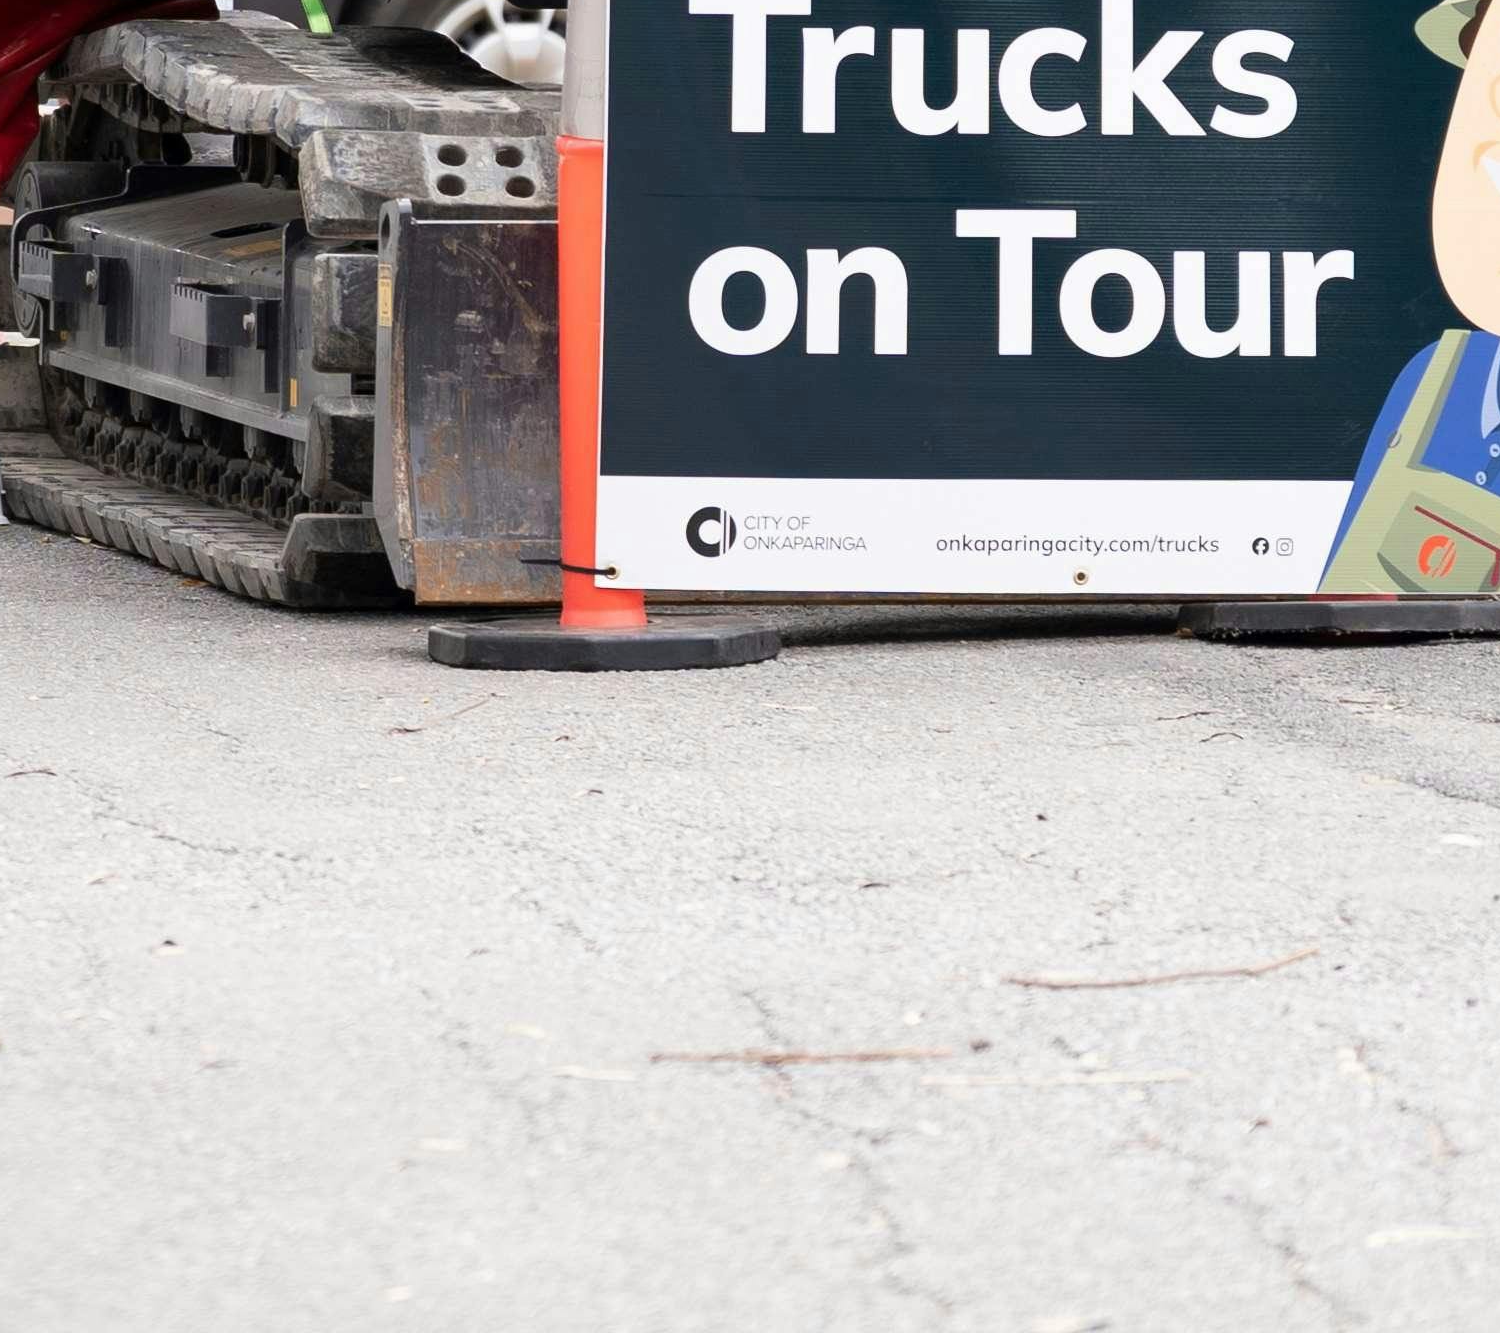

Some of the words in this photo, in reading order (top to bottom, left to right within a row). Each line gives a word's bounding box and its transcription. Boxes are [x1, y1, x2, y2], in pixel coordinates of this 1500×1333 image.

[688, 245, 909, 358] on
[956, 209, 1355, 358] Tour
[744, 516, 782, 531] CITY
[786, 516, 811, 531] OF
[744, 536, 868, 551] ONKAPARINGA
[936, 535, 1220, 558] onkaparingacity.com/trucks
